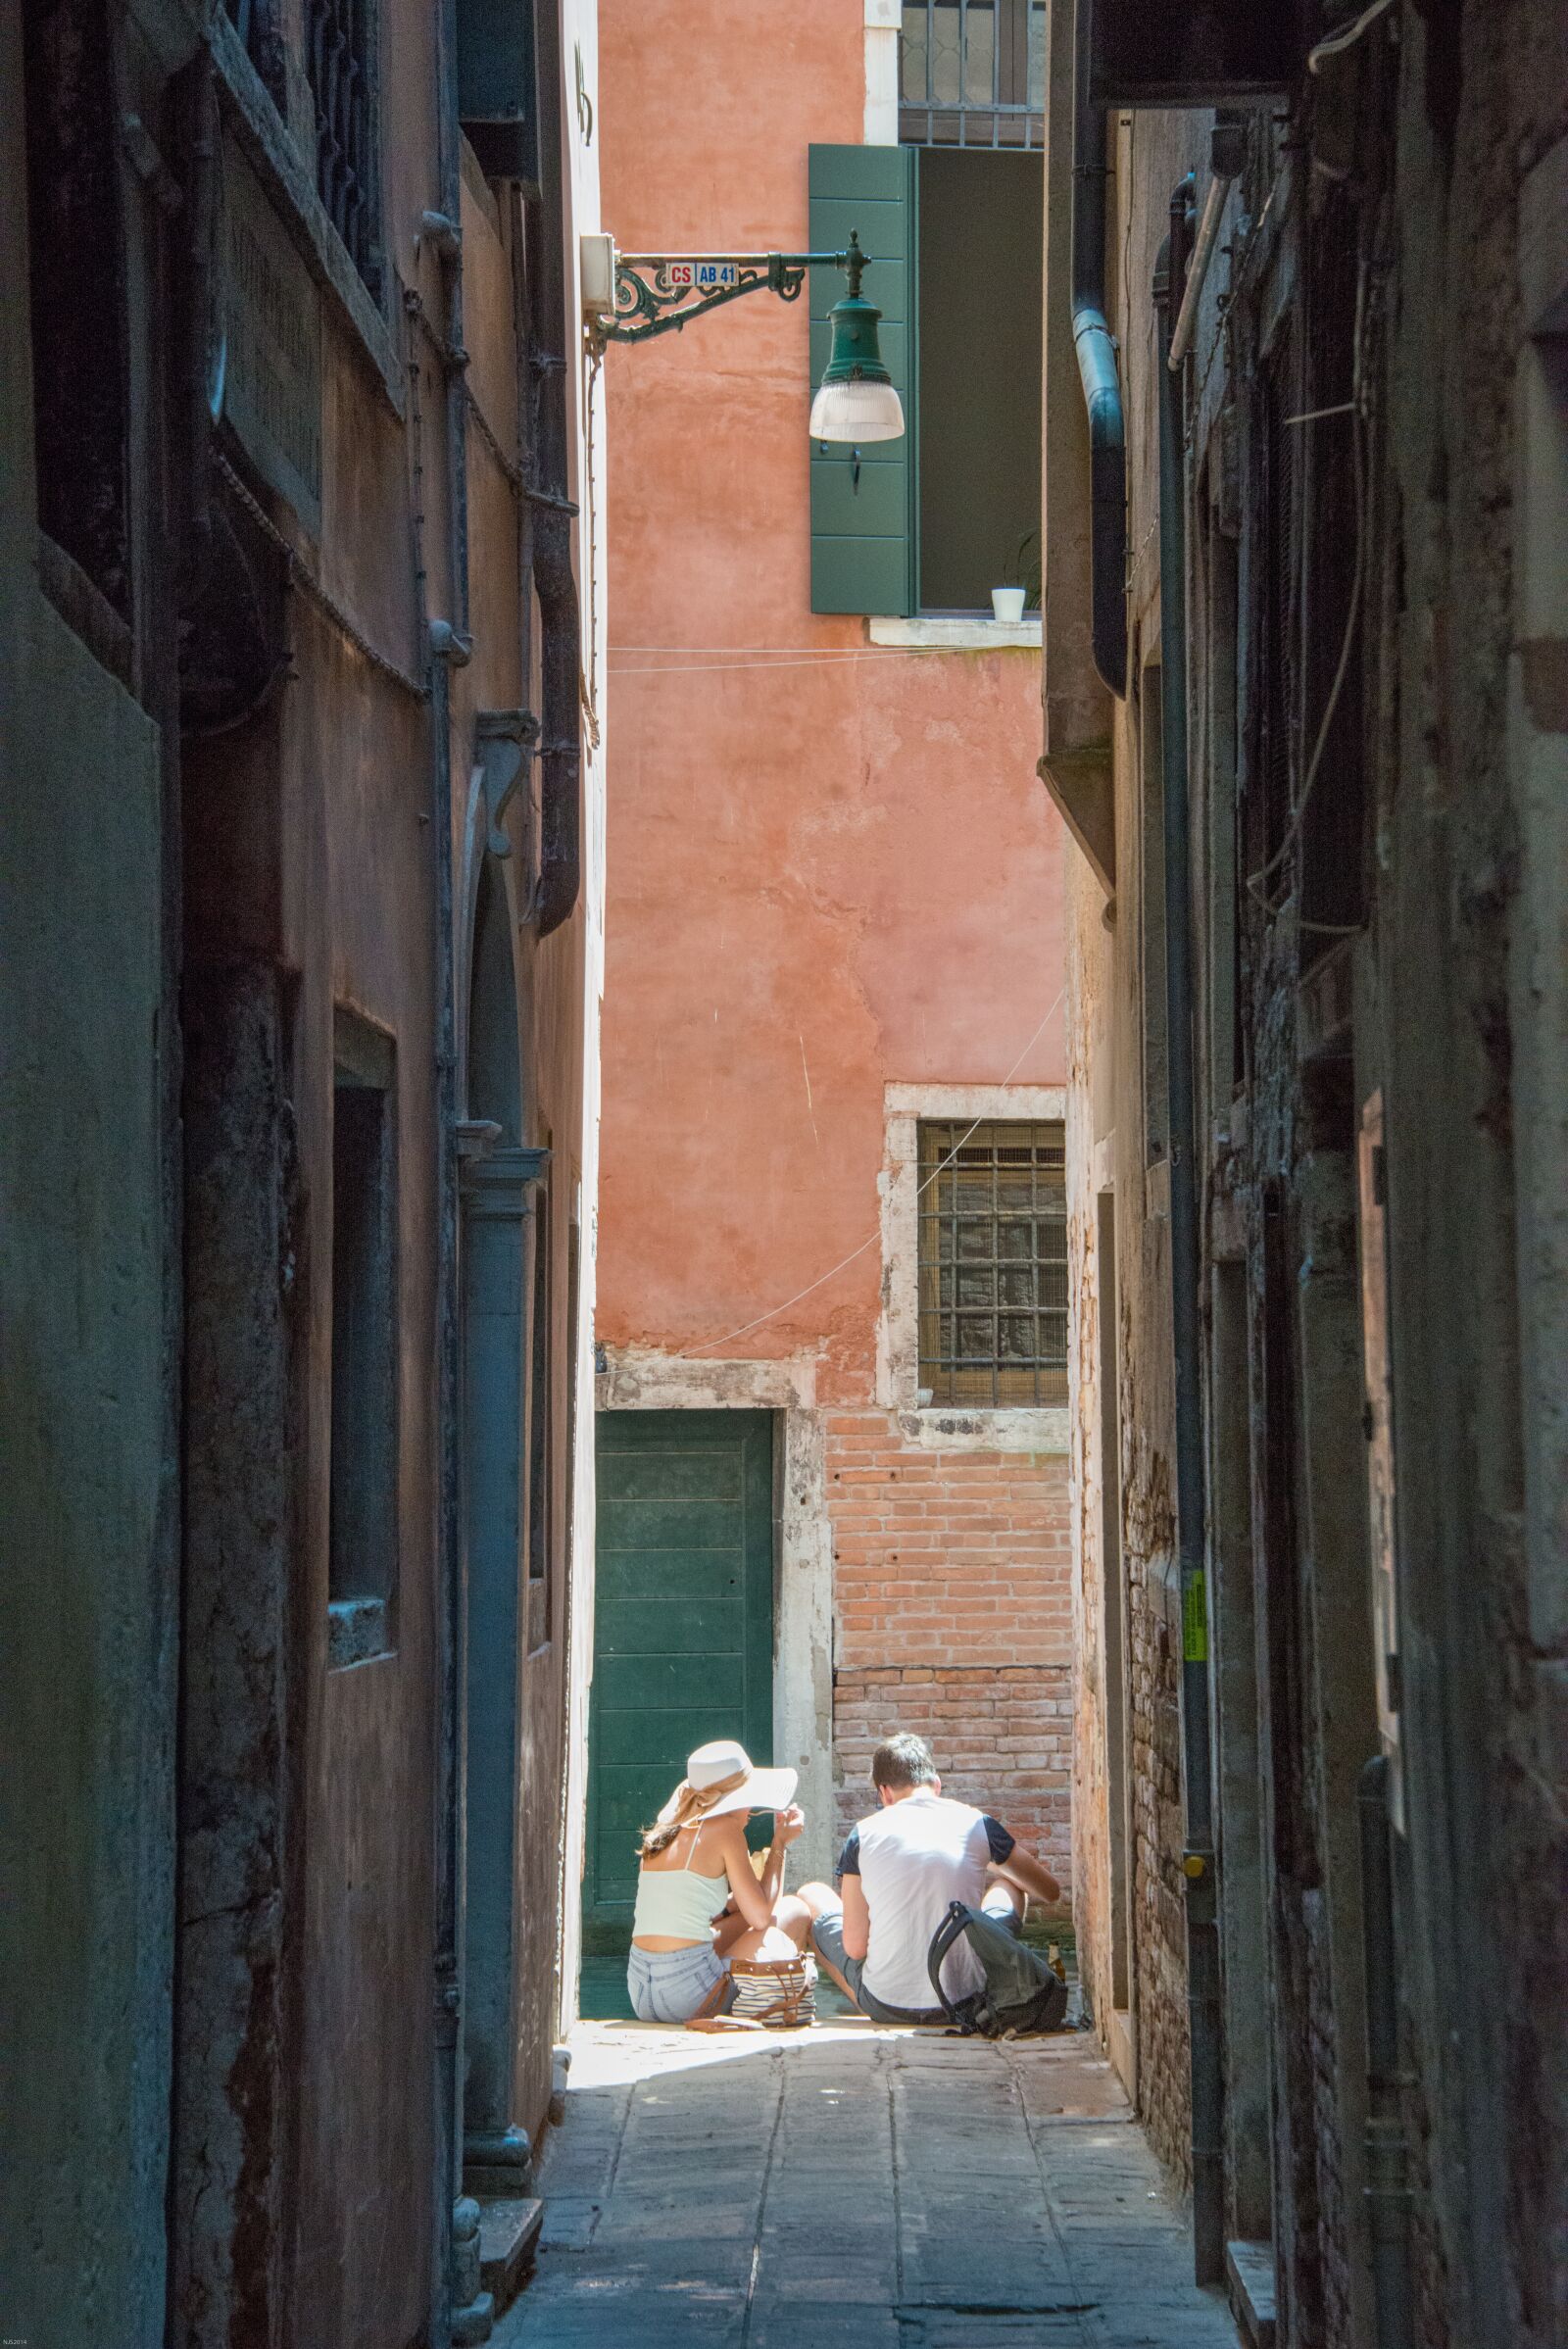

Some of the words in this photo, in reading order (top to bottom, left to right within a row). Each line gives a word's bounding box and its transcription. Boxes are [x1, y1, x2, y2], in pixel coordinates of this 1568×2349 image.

[671, 266, 691, 283] CS
[700, 266, 716, 282] AB
[720, 266, 734, 282] 41
